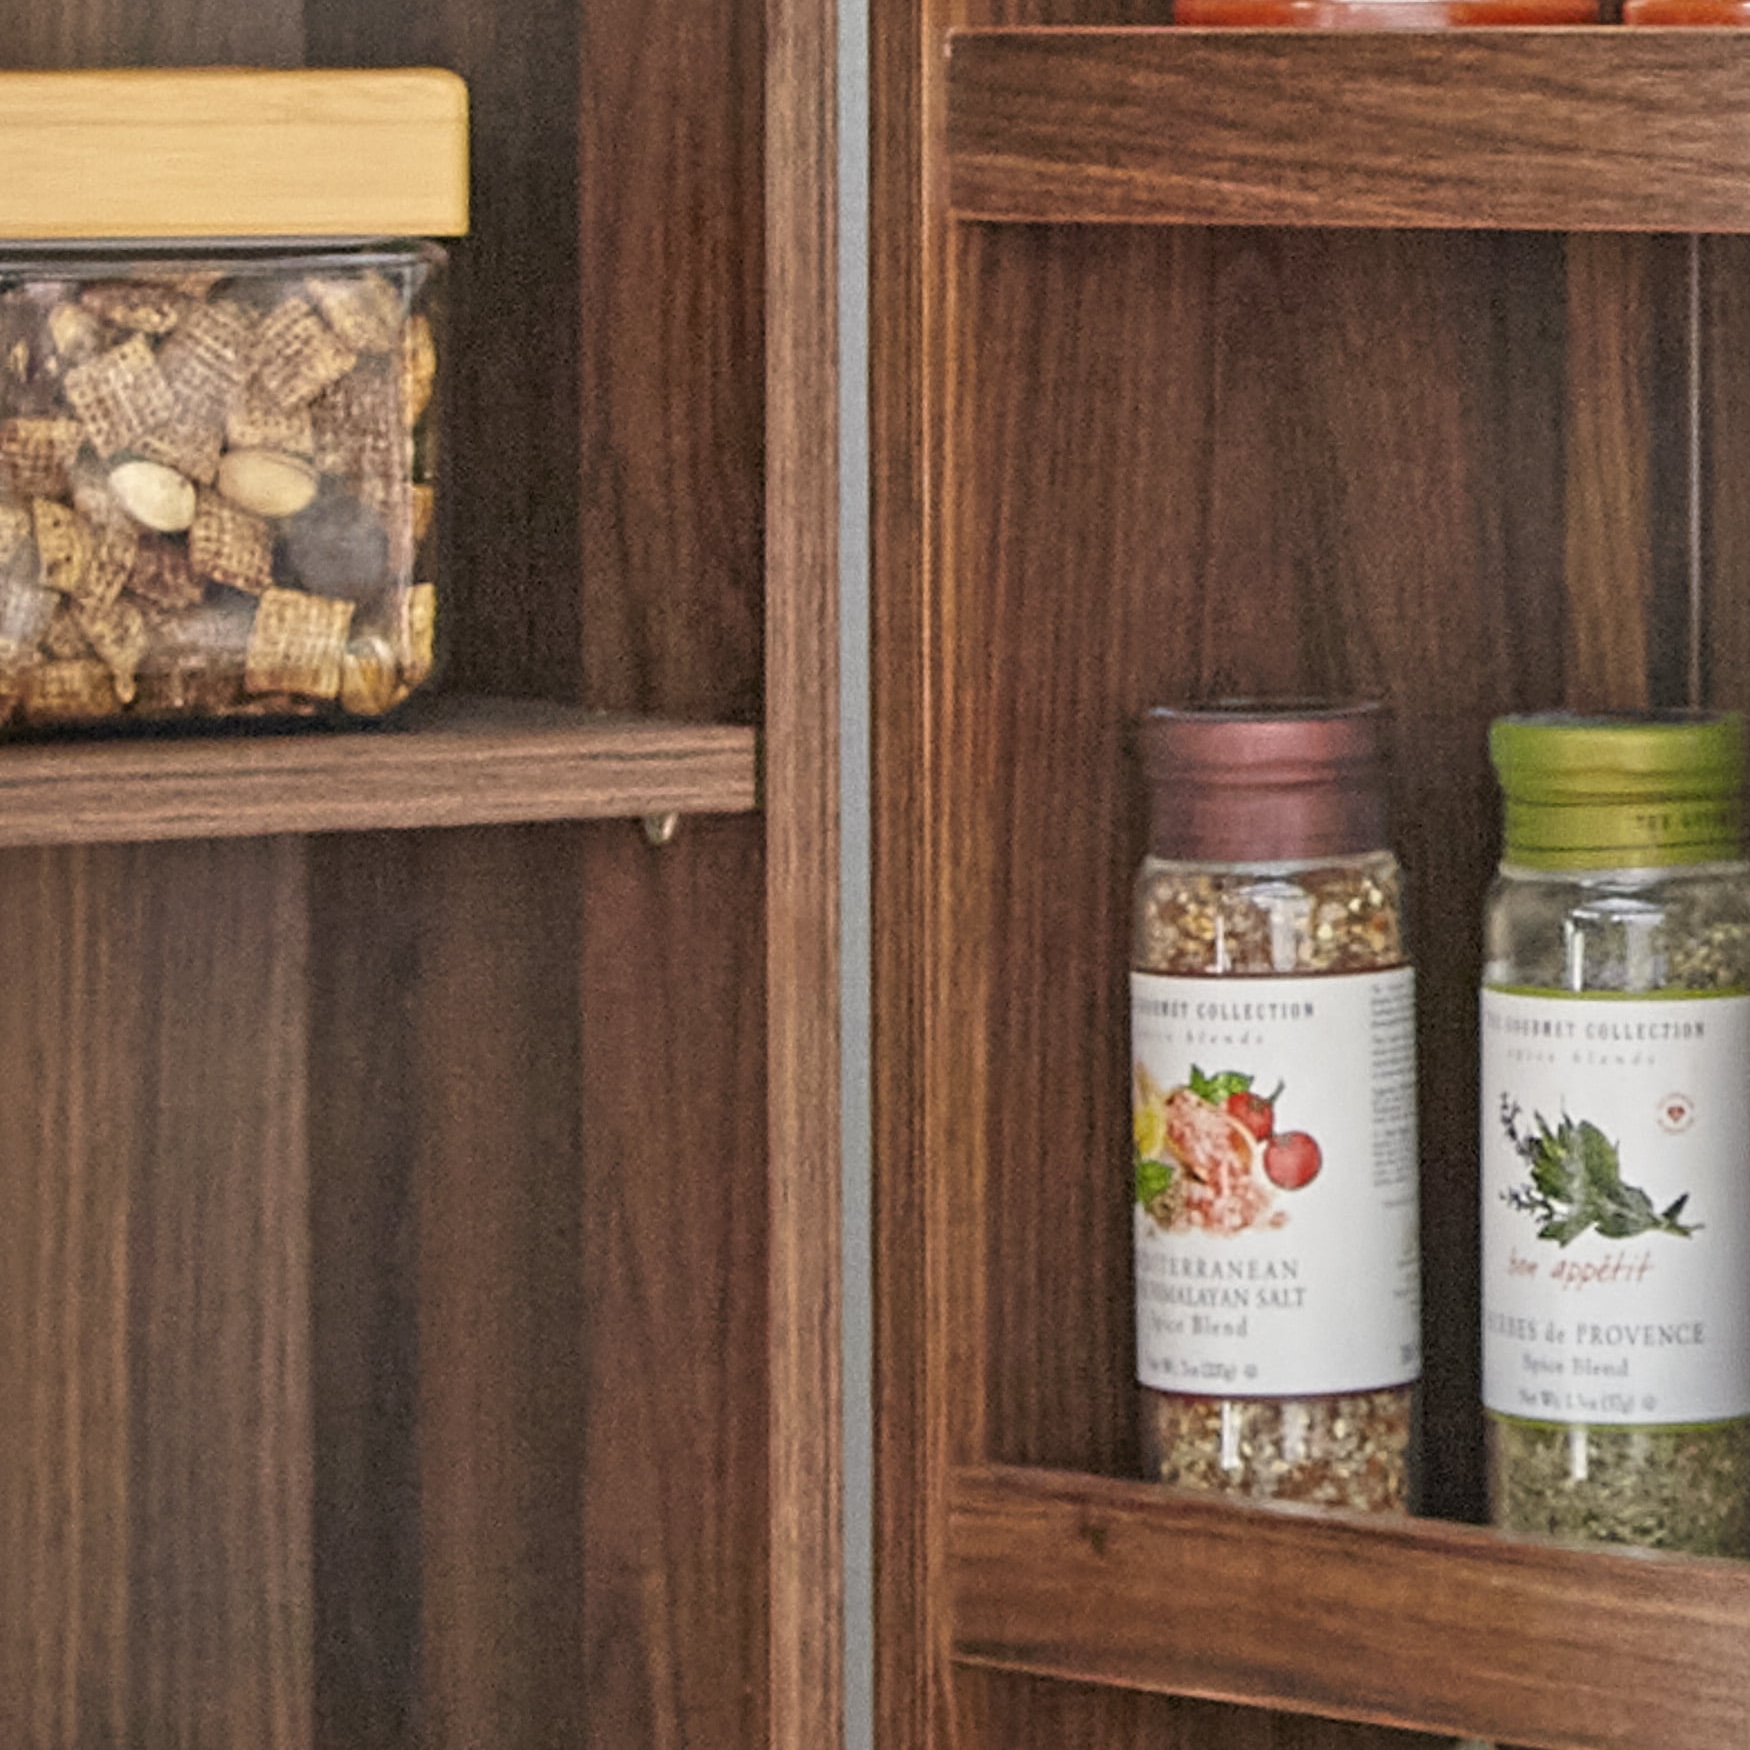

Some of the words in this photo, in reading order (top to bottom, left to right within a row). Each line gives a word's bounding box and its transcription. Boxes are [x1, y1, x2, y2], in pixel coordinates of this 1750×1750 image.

[1196, 1002, 1315, 1021] COLLECTION
[1585, 1021, 1705, 1041] COLLECTION
[1256, 1287, 1307, 1307] SALT
[1191, 1314, 1248, 1338] Blend
[1544, 1320, 1565, 1344] de
[1576, 1321, 1705, 1346] PROVENCE
[1572, 1356, 1629, 1378] Blend
